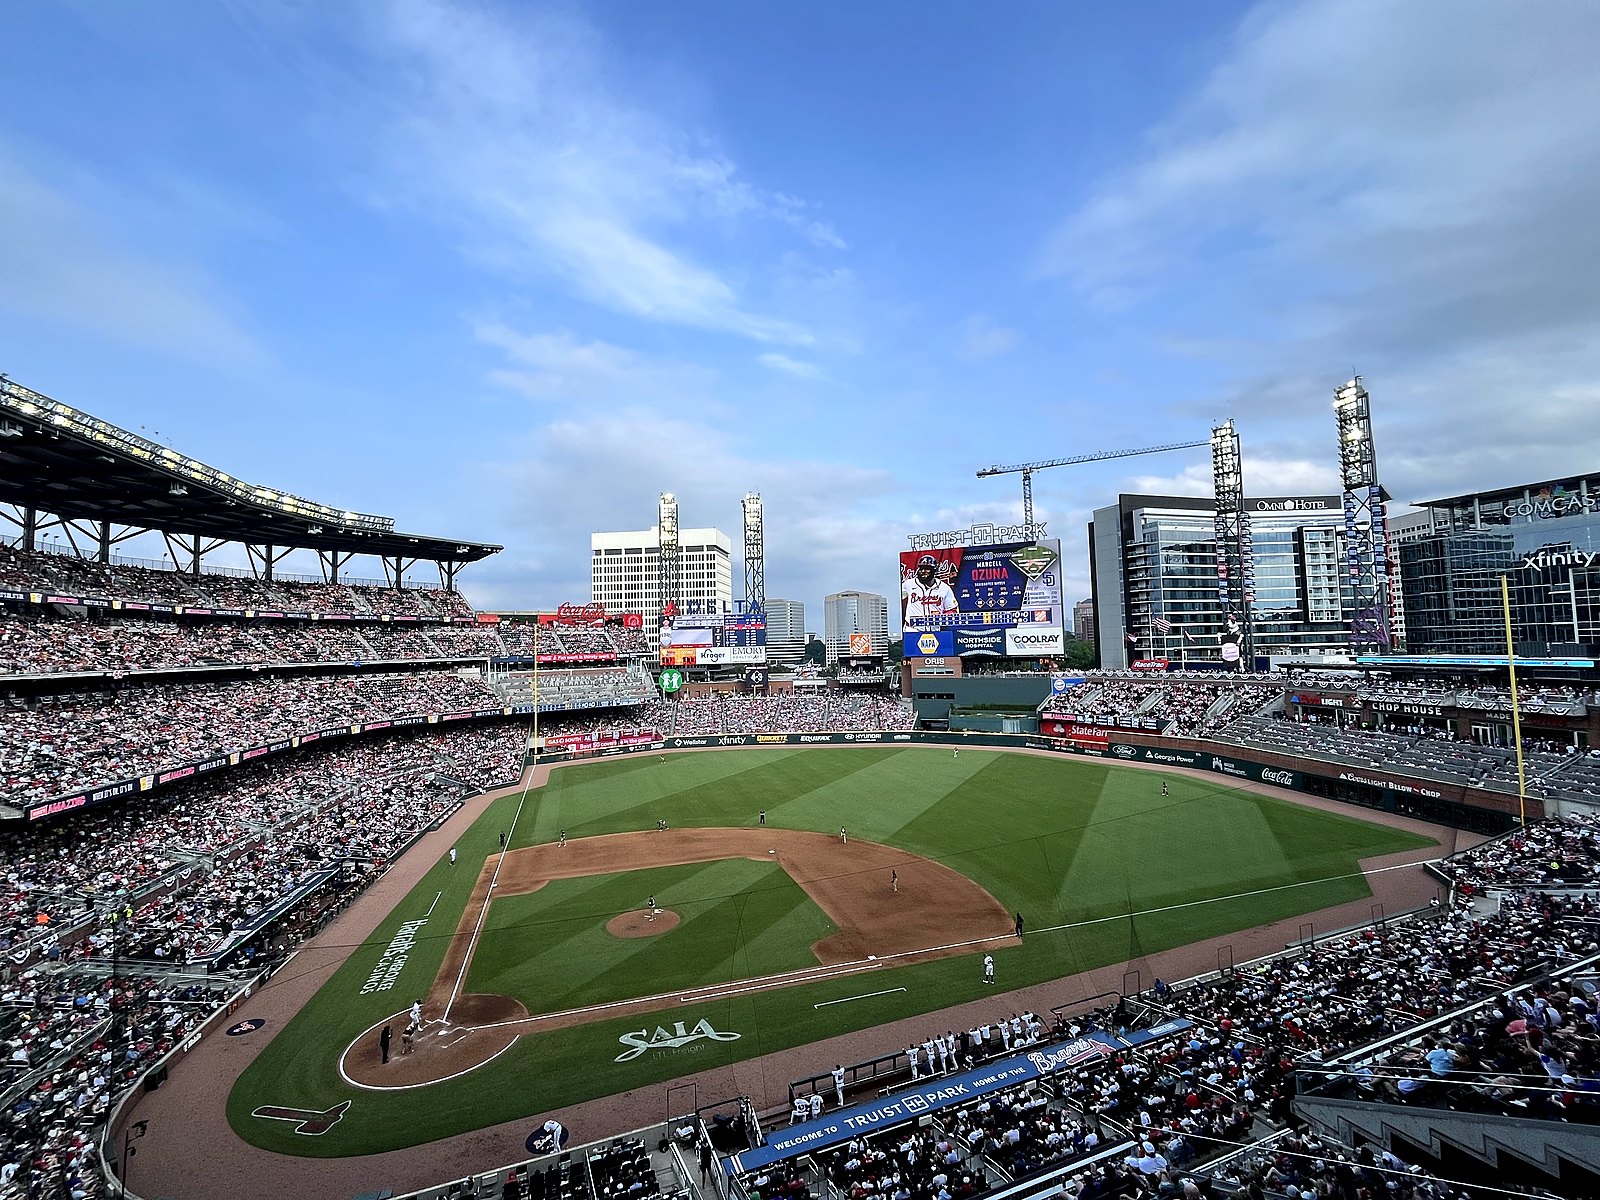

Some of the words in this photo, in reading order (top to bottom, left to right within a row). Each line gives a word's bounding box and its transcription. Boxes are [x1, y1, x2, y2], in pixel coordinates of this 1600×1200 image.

[1256, 500, 1284, 511] OMNI
[1295, 499, 1328, 510] HOTEL
[1504, 491, 1600, 517] COMCAS
[907, 530, 968, 548] TRUIST
[999, 522, 1048, 540] PARK
[1522, 549, 1597, 572] xfinity
[971, 568, 1008, 581] OZUNA
[920, 639, 936, 648] NAPA
[957, 636, 1002, 644] NORTHSIDE
[1013, 634, 1060, 644] COOLRAY
[700, 649, 726, 662] Kroger
[732, 647, 764, 655] EMORY
[924, 657, 945, 665] ORIS
[1321, 698, 1343, 706] LIGHT
[1372, 702, 1400, 712] CHOP
[1403, 705, 1442, 715] HOUSE
[1485, 712, 1511, 720] MADE
[718, 736, 746, 745] xfinity
[1154, 752, 1176, 762] Georgia
[1176, 755, 1195, 763] Power
[1367, 778, 1387, 788] LIGHT
[359, 956, 393, 995] CASINOS
[376, 954, 409, 992] CHEROKEE
[613, 1018, 742, 1062] SAIA
[1027, 1038, 1092, 1074] Braves
[774, 1129, 824, 1151] WELCOME
[823, 1125, 838, 1136] TO
[843, 1103, 903, 1130] TRUIST
[926, 1083, 970, 1104] PARK
[972, 1075, 998, 1087] HOME
[997, 1071, 1008, 1080] OF
[1008, 1066, 1026, 1077] THE
